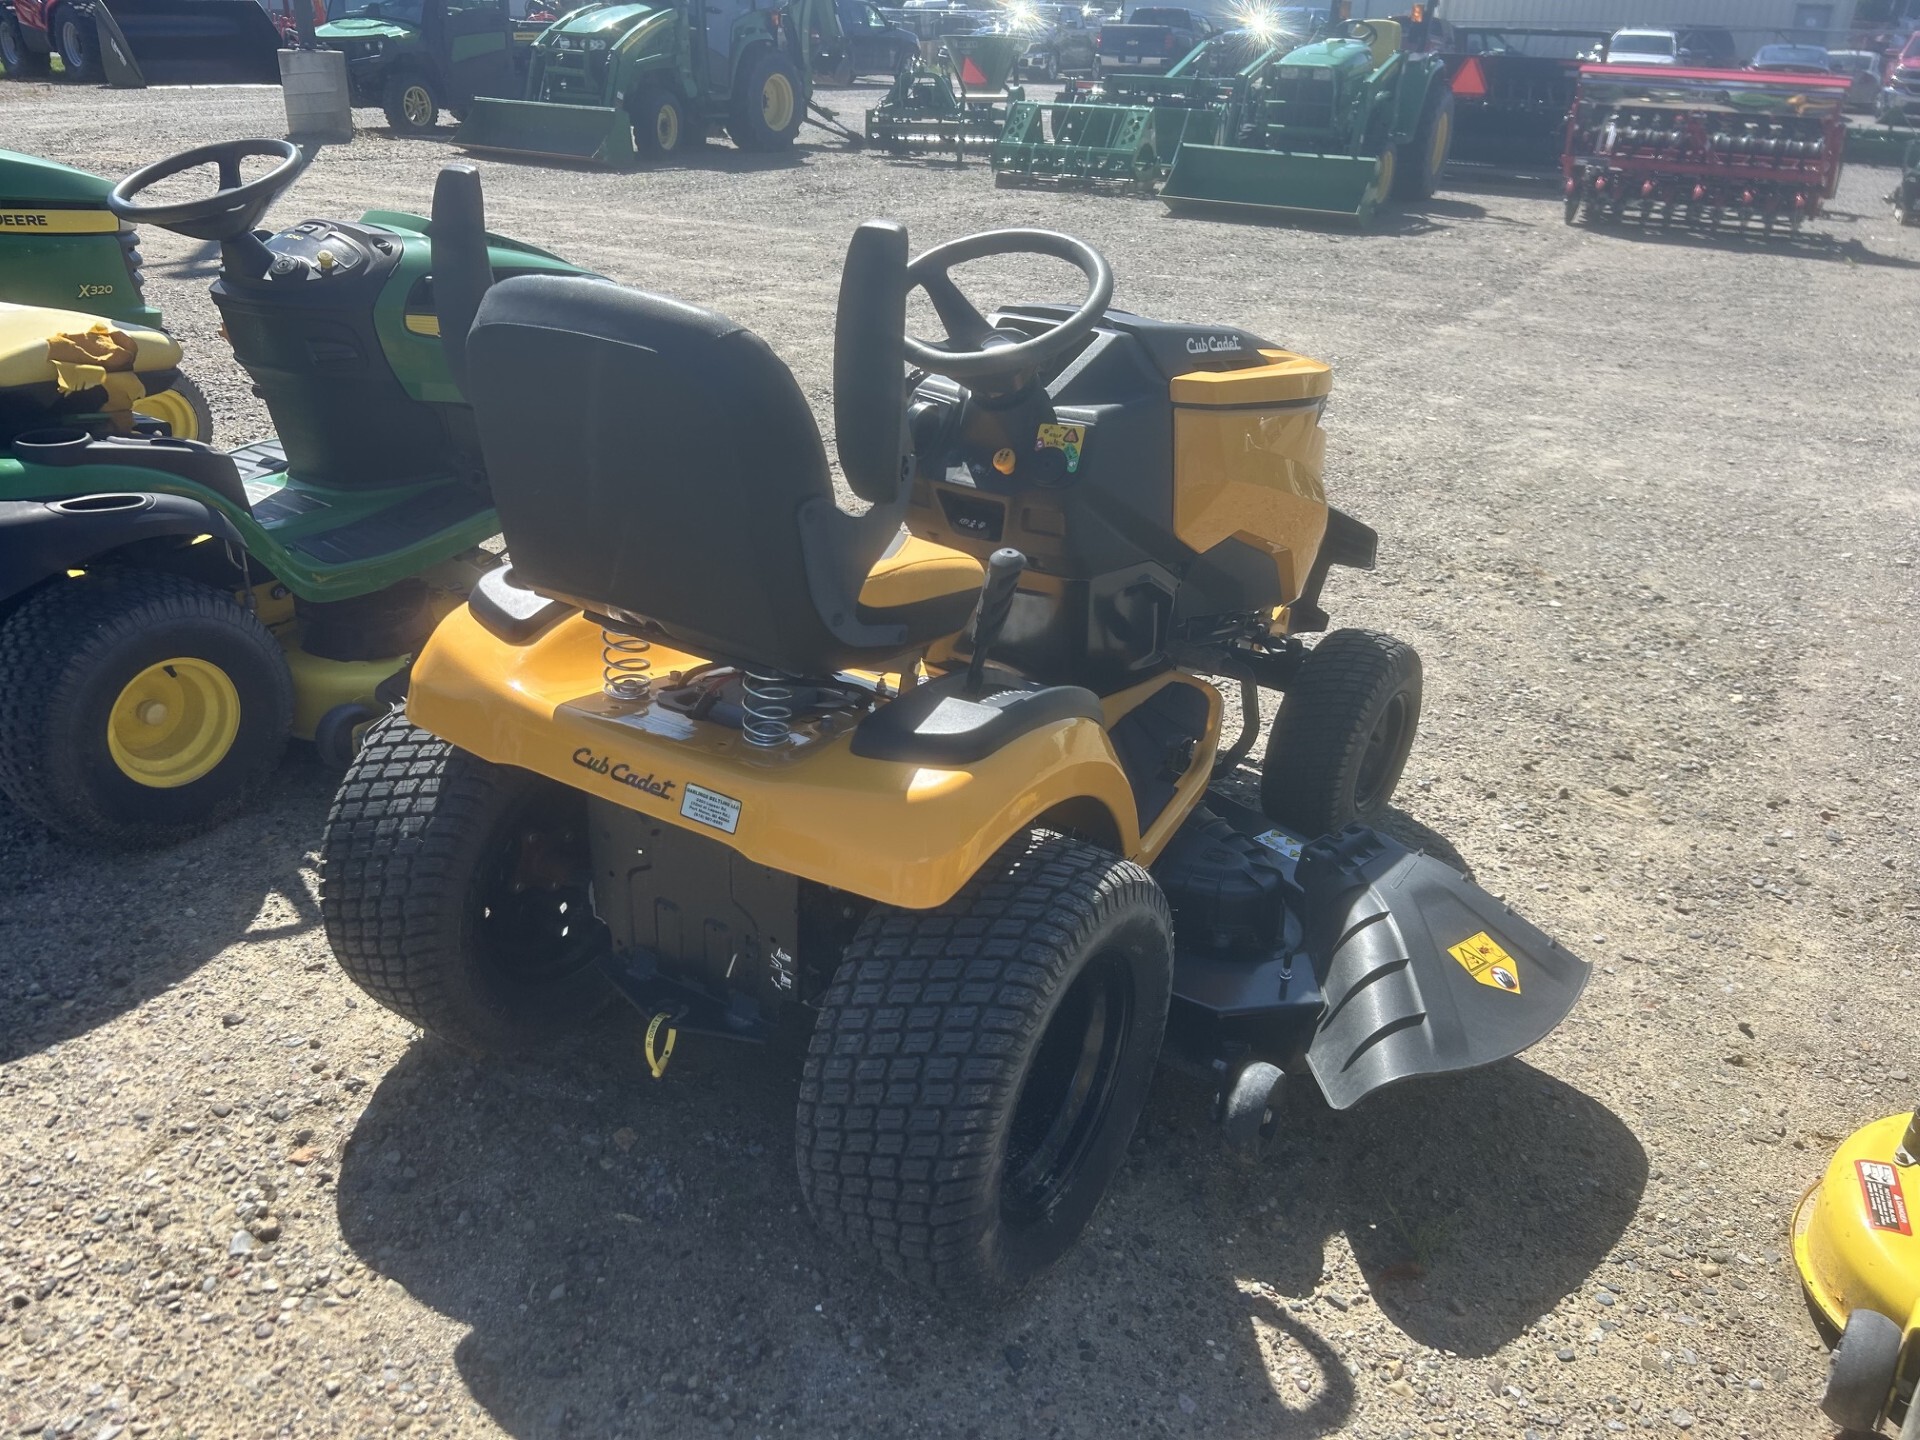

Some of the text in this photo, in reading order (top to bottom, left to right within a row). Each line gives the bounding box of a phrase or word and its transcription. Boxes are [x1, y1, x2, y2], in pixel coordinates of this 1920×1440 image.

[0, 215, 48, 226] EERE
[78, 284, 113, 298] X320
[1186, 335, 1241, 354] Cub Cadet
[572, 747, 676, 800] Cub Cadet
[1896, 1200, 1908, 1224] DANGER
